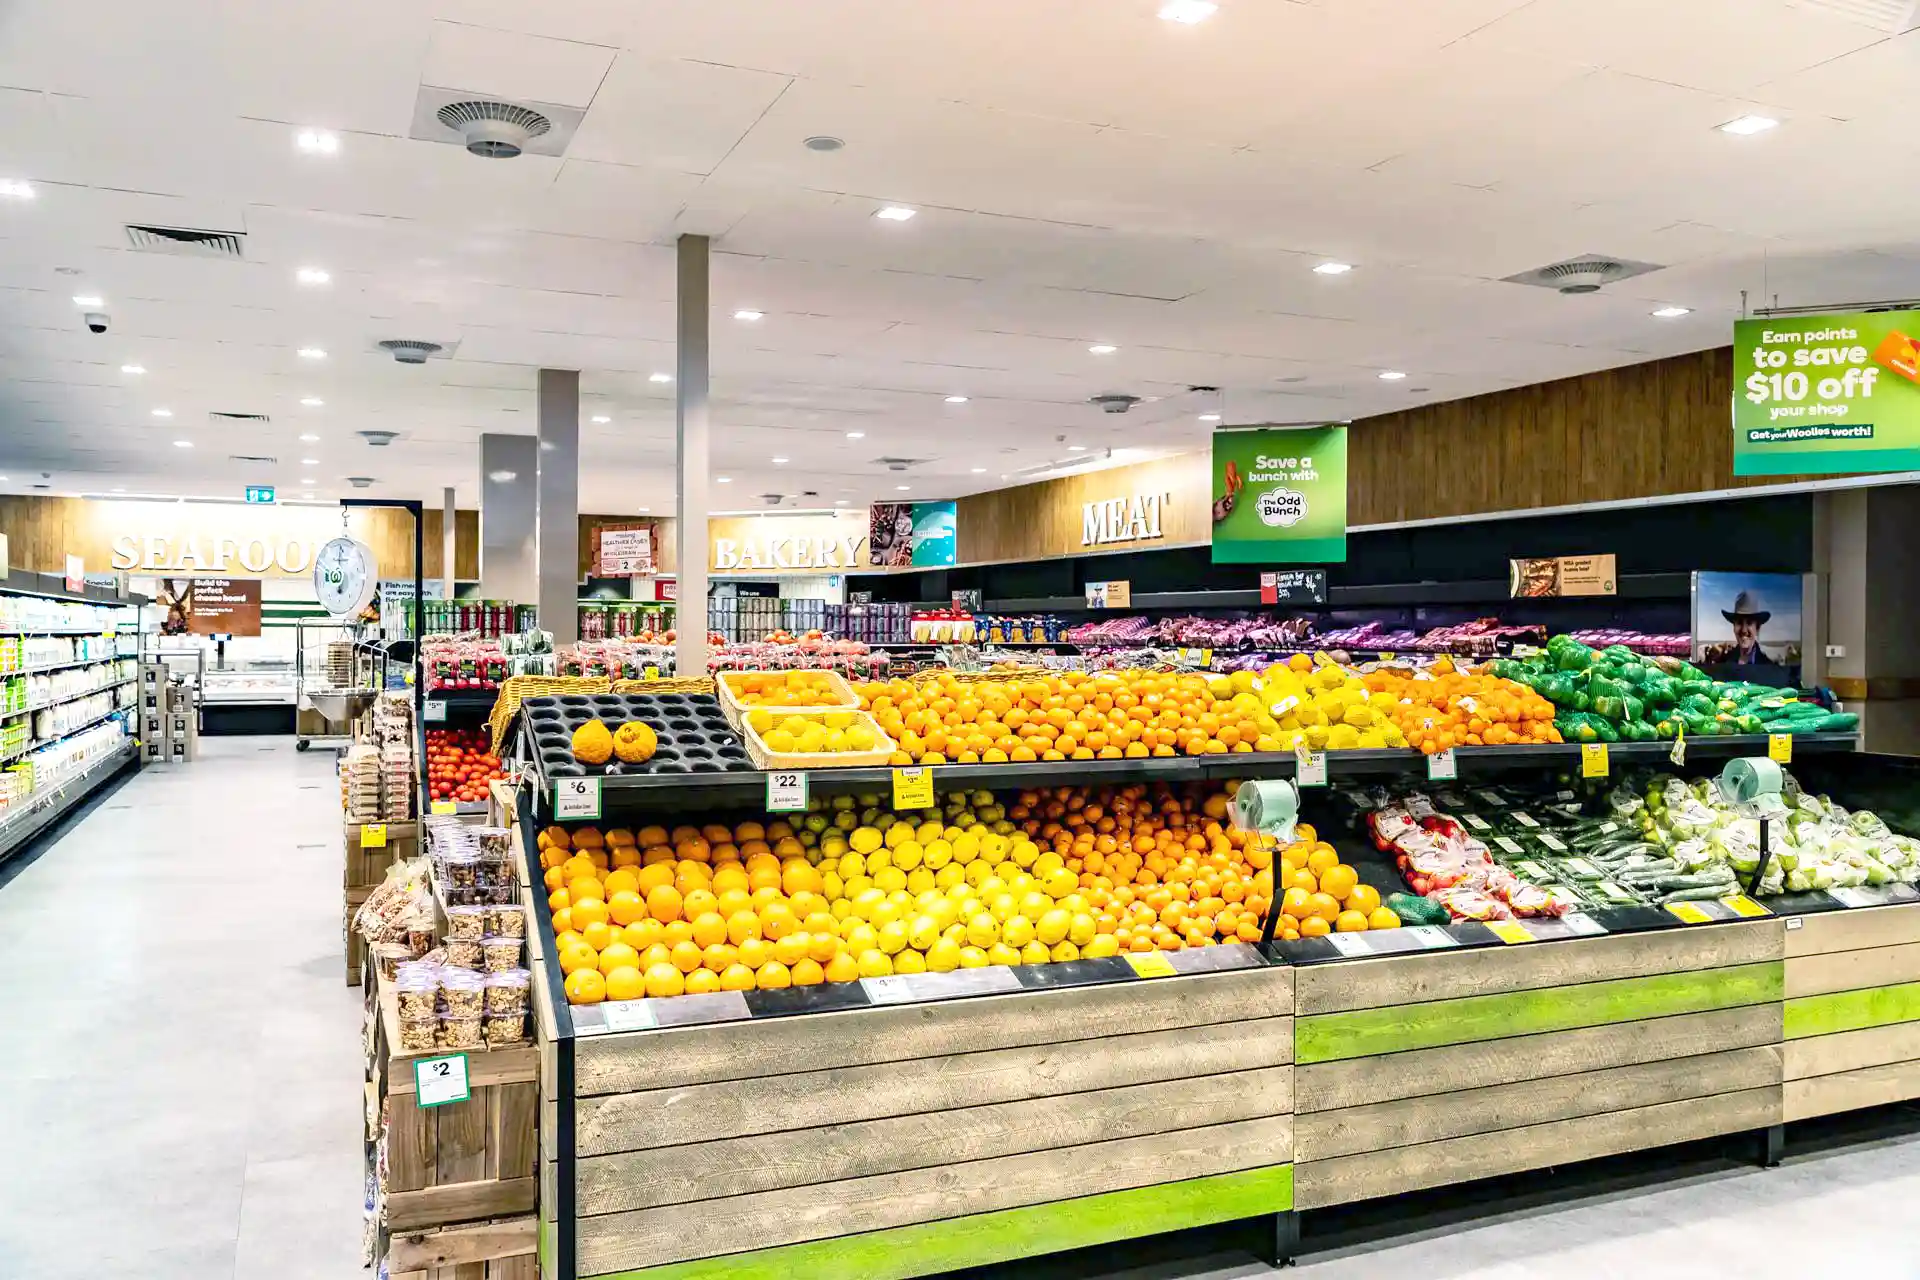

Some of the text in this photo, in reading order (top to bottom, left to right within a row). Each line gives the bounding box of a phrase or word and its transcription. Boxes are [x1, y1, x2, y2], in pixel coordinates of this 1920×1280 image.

[1762, 328, 1858, 345] Earn points
[1753, 345, 1867, 368] to save
[1745, 370, 1809, 404] $10
[1817, 367, 1880, 399] off
[1770, 404, 1848, 420] your shop
[1831, 426, 1871, 436] worth!
[1256, 455, 1312, 469] Save a
[1248, 469, 1319, 482] bunch with
[1277, 496, 1301, 506] Odd
[1264, 506, 1301, 516] Bunch
[1081, 493, 1169, 547] MEAT
[111, 534, 318, 573] SEAFOO
[714, 535, 866, 569] BAKERY
[570, 781, 586, 793] $6
[774, 774, 797, 786] $22
[432, 1061, 450, 1077] $2
